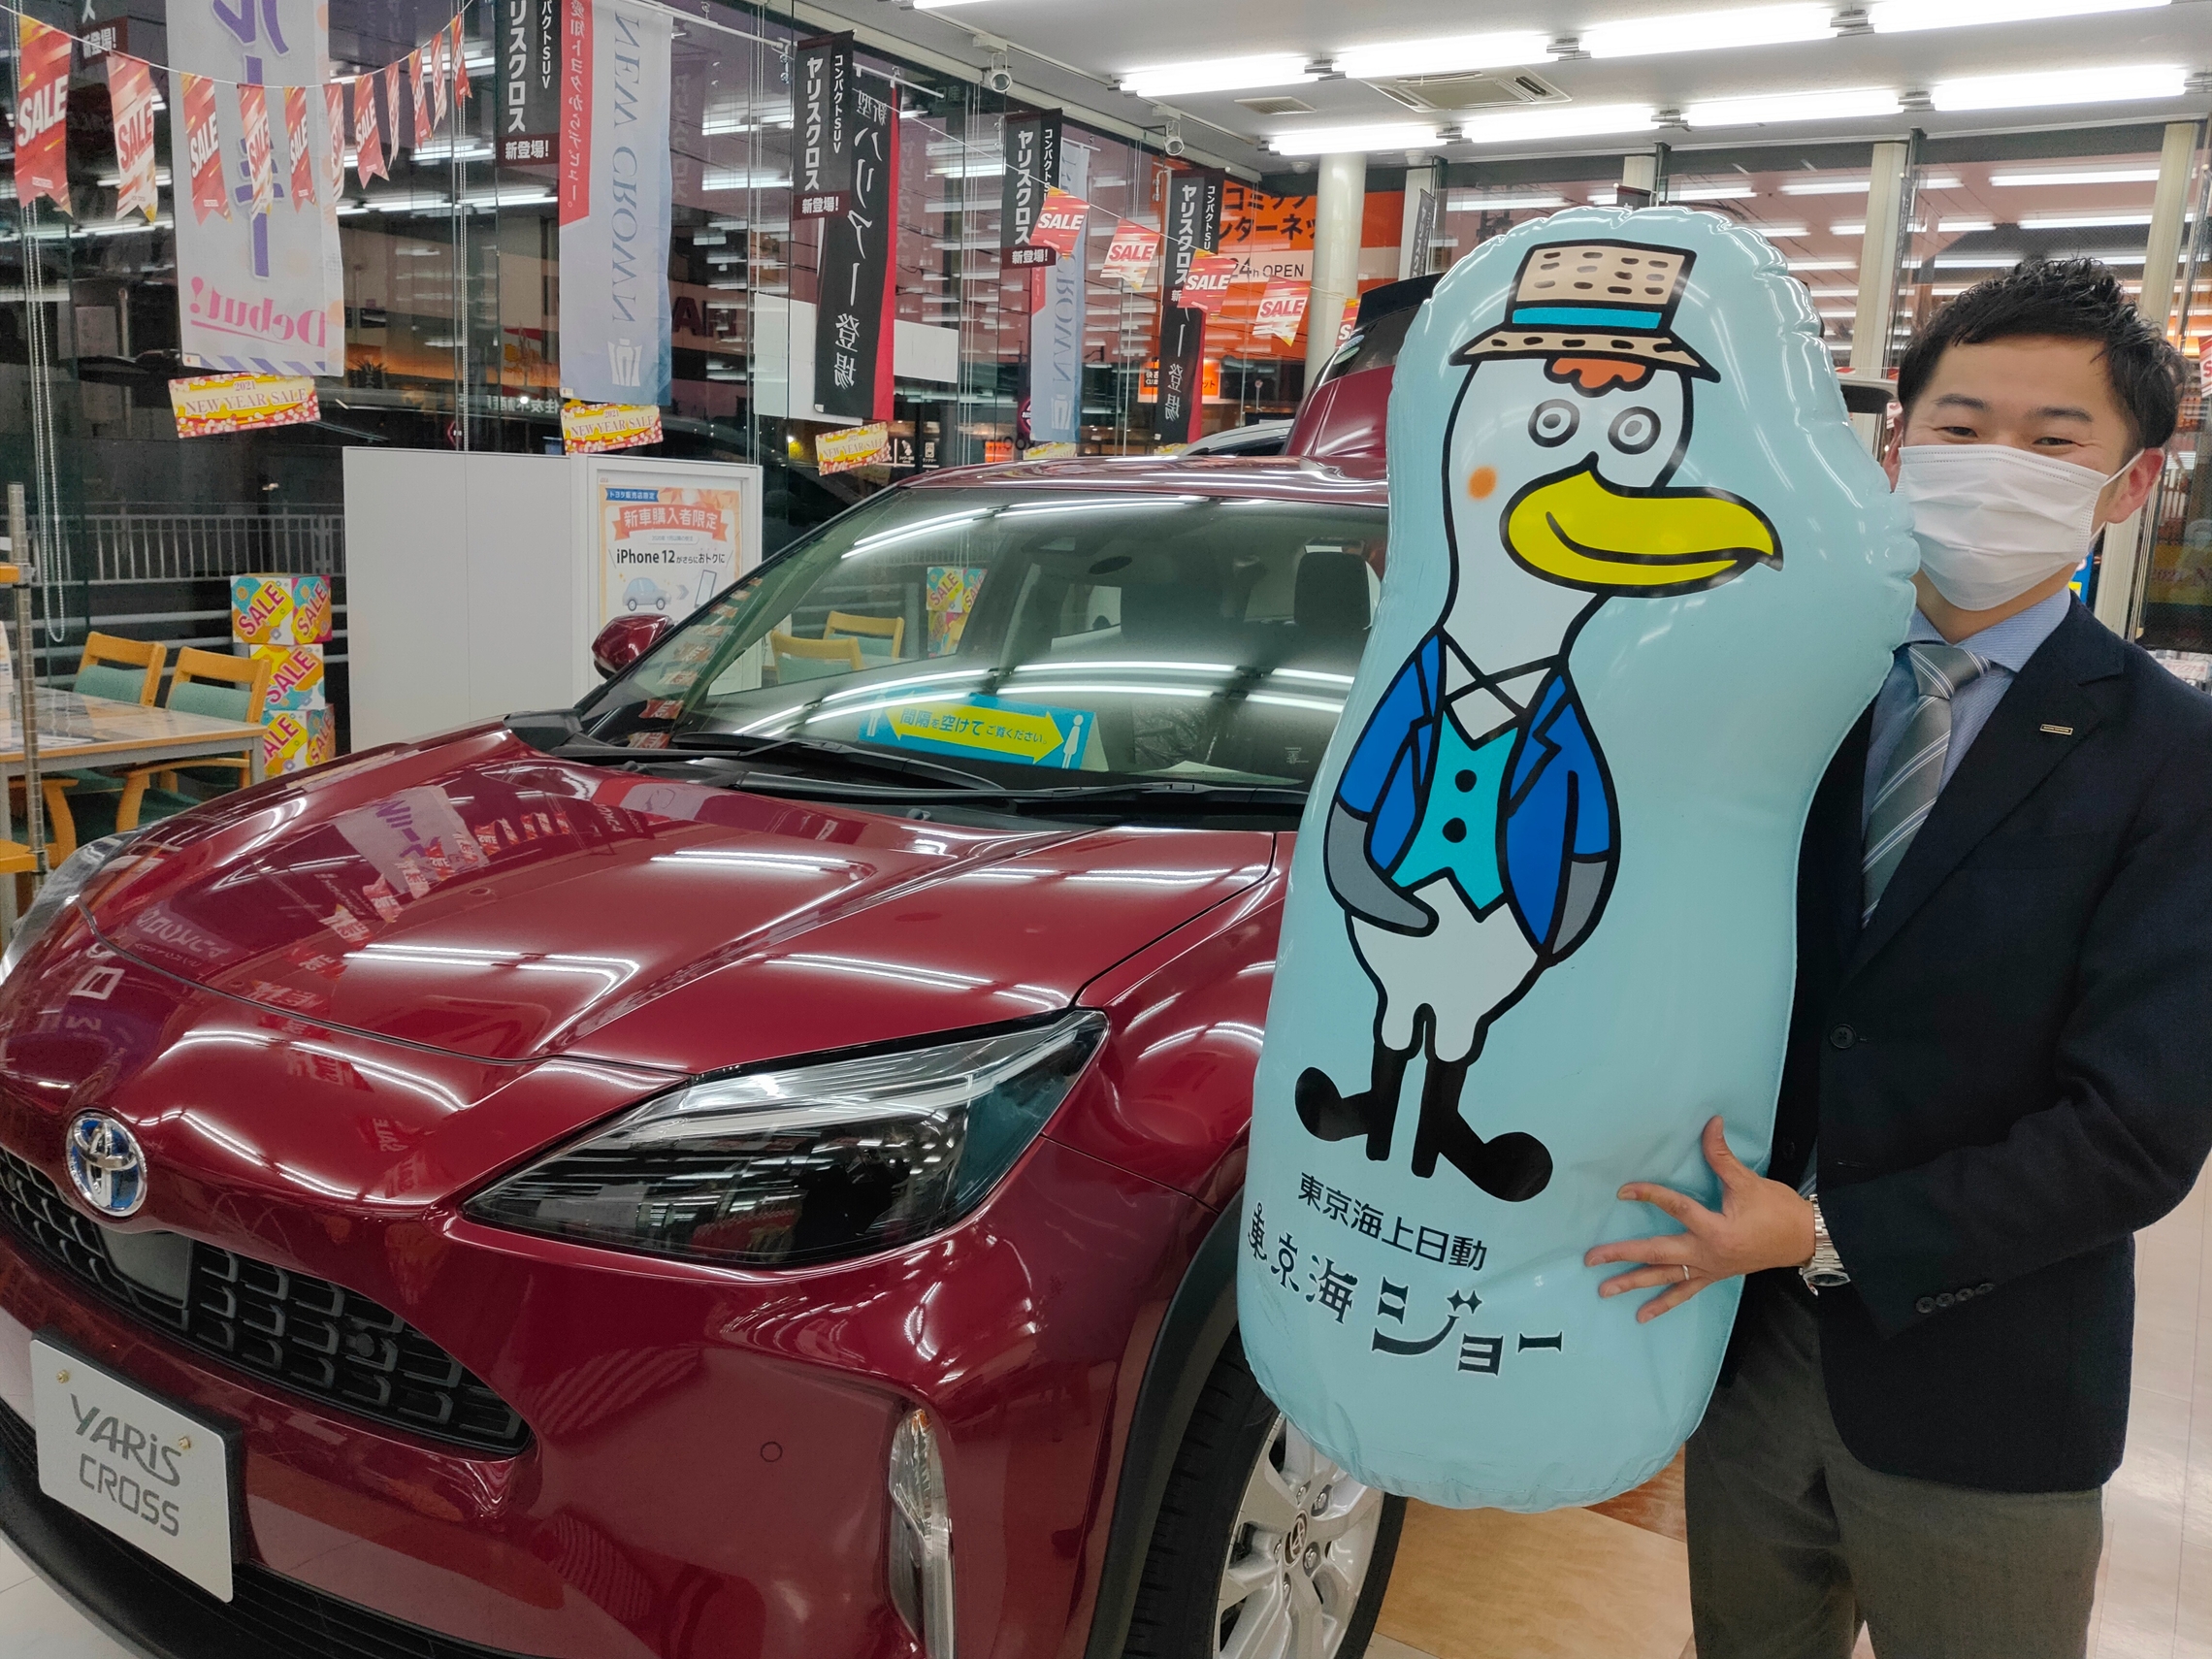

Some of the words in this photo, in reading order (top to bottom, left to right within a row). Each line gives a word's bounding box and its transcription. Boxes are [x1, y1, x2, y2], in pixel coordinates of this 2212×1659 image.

[17, 75, 69, 146] SALE
[804, 56, 824, 191] ヤリスクロス
[832, 54, 843, 154] コンパクトSUV
[190, 111, 219, 179] SALE
[290, 115, 309, 175] SALE
[355, 99, 376, 153] SALE
[505, 139, 549, 160] 新登場!
[801, 196, 840, 215] 新登場!
[1015, 130, 1034, 245] ヤリスクロス
[1037, 213, 1085, 230] SALE
[1012, 248, 1049, 264] 新登場!
[1108, 243, 1155, 263] SALE
[1262, 264, 1305, 278] OPEN
[1185, 274, 1231, 291] SALE
[1260, 299, 1306, 318] SALE
[185, 398, 220, 415] NEW
[223, 393, 267, 409] YEAR
[271, 388, 308, 405] SALE
[234, 379, 256, 392] 2021
[570, 422, 595, 438] NEW
[596, 418, 627, 434] YEAR
[629, 414, 654, 429] SALE
[603, 409, 620, 418] 2021
[624, 506, 718, 531] 新車購入者限定
[616, 548, 659, 564] iPhone
[662, 549, 675, 564] 12
[297, 582, 329, 636] SALE
[928, 571, 959, 606] SALE
[239, 583, 285, 636] SALE
[266, 650, 316, 703] SALE
[264, 716, 299, 764] ALE
[309, 714, 333, 764] SALE
[1297, 1172, 1487, 1271] 東京海上日動
[1248, 1202, 1562, 1376] 東京海ジョー
[79, 1452, 180, 1537] CROSS
